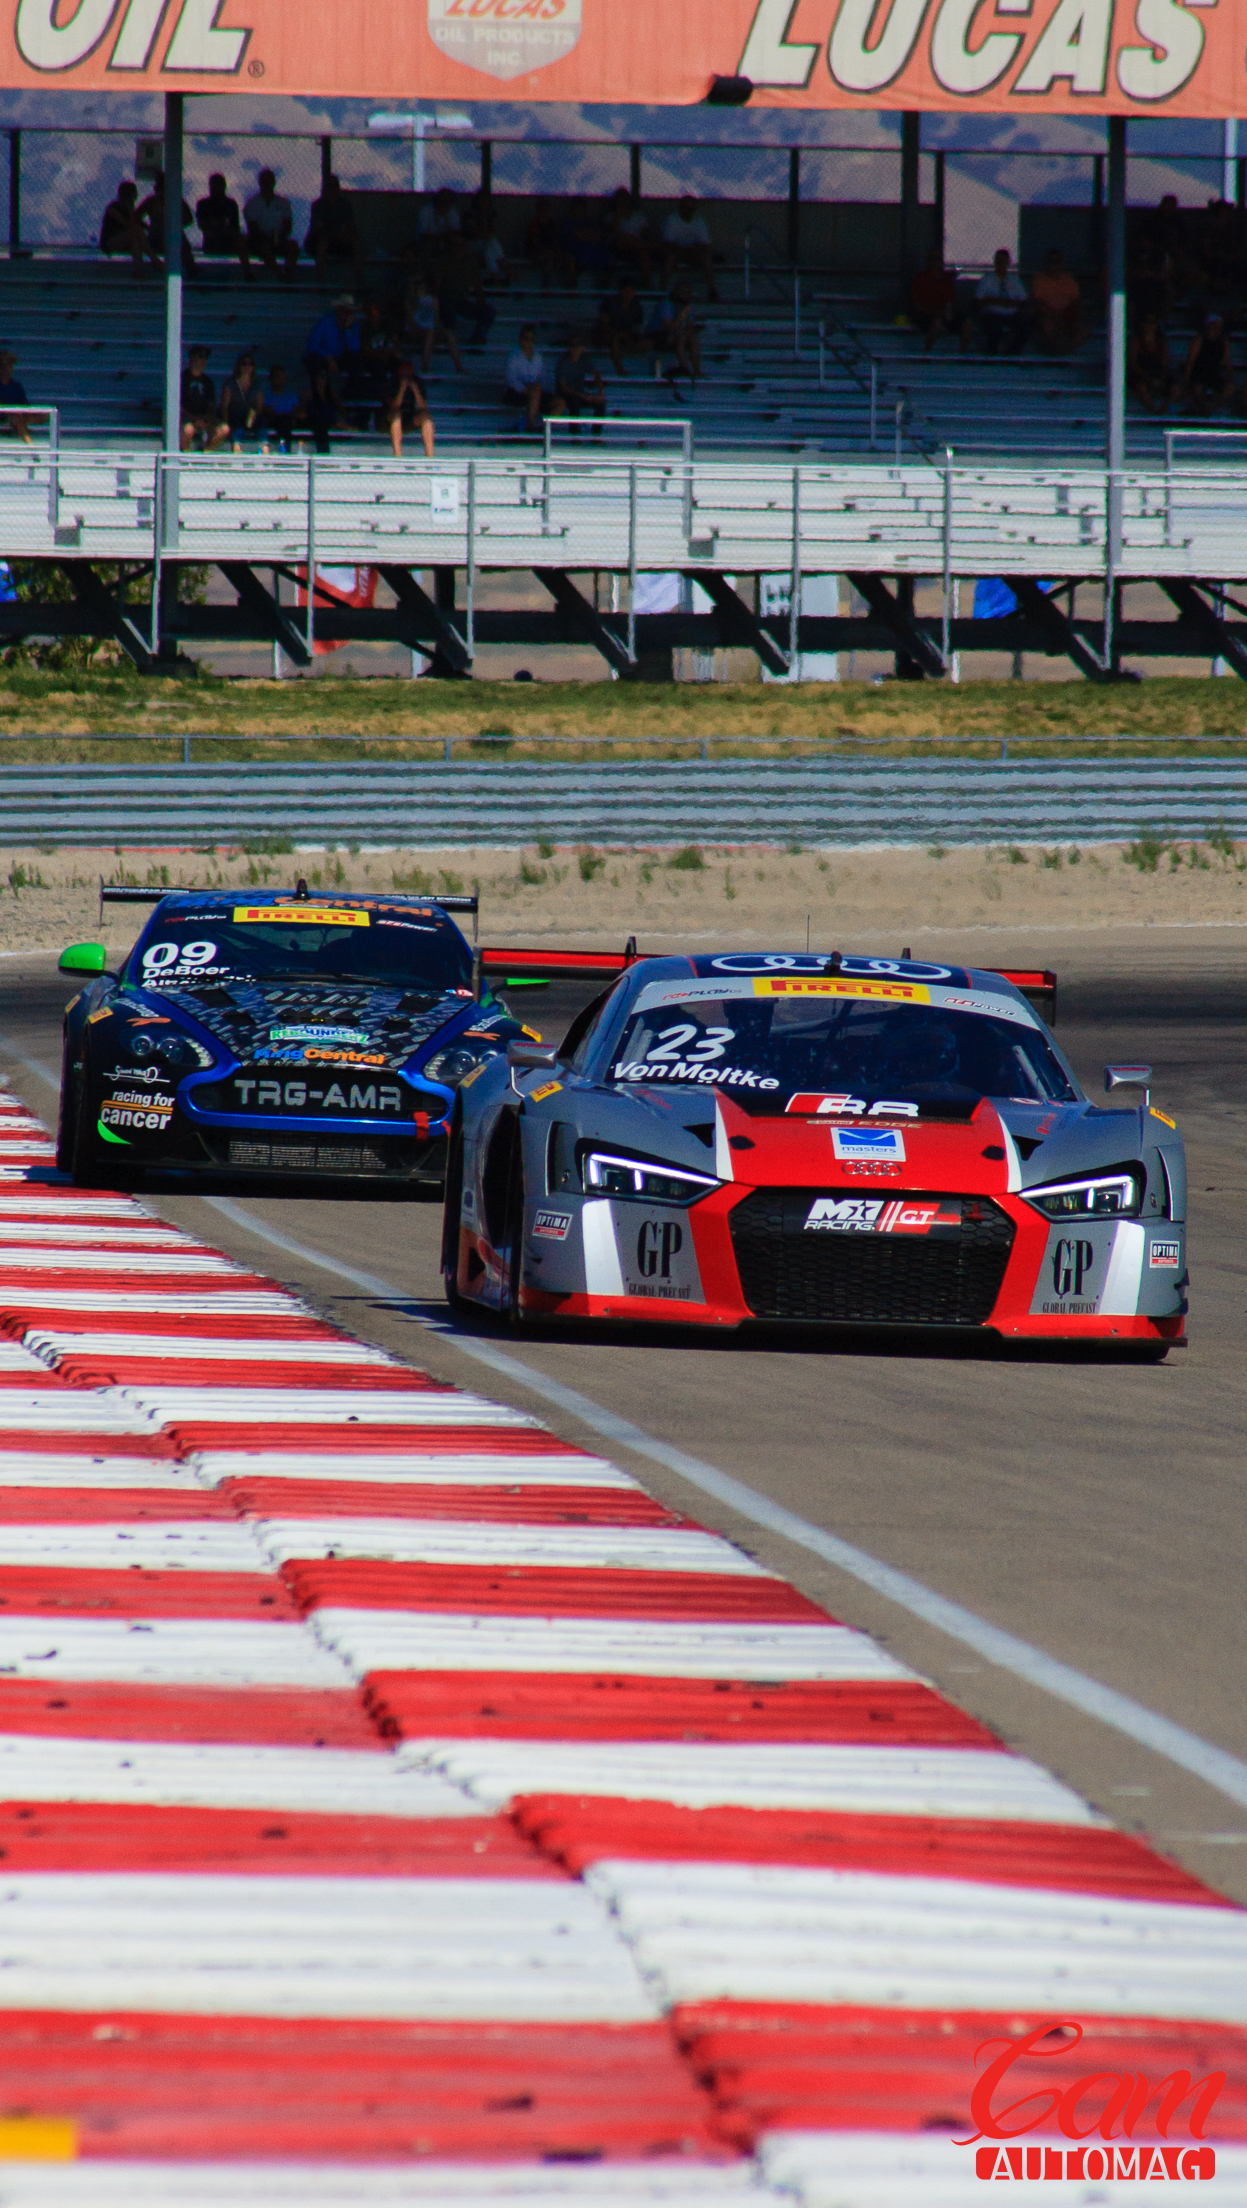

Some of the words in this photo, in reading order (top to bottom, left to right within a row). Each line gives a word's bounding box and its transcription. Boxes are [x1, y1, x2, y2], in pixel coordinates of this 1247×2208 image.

[435, 27, 466, 43] OIL
[473, 27, 576, 45] PRODUCTS
[736, 0, 1220, 102] LUCAS
[246, 909, 357, 922] PIRELLI
[142, 941, 217, 968] 09
[142, 966, 231, 979] DeBoer
[770, 980, 915, 998] PIRELLI
[646, 1024, 735, 1062] 23
[253, 1048, 386, 1065] RingCentral
[112, 1090, 152, 1108] racing
[153, 1092, 176, 1107] for
[234, 1079, 401, 1111] TRG-AMR
[101, 1107, 173, 1130] cancer
[841, 1146, 897, 1154] masters
[536, 1214, 568, 1229] OPTIMA
[899, 1210, 935, 1225] GT
[637, 1220, 683, 1279] GP
[1053, 1238, 1094, 1296] GP
[1042, 1302, 1066, 1314] GLOBAL
